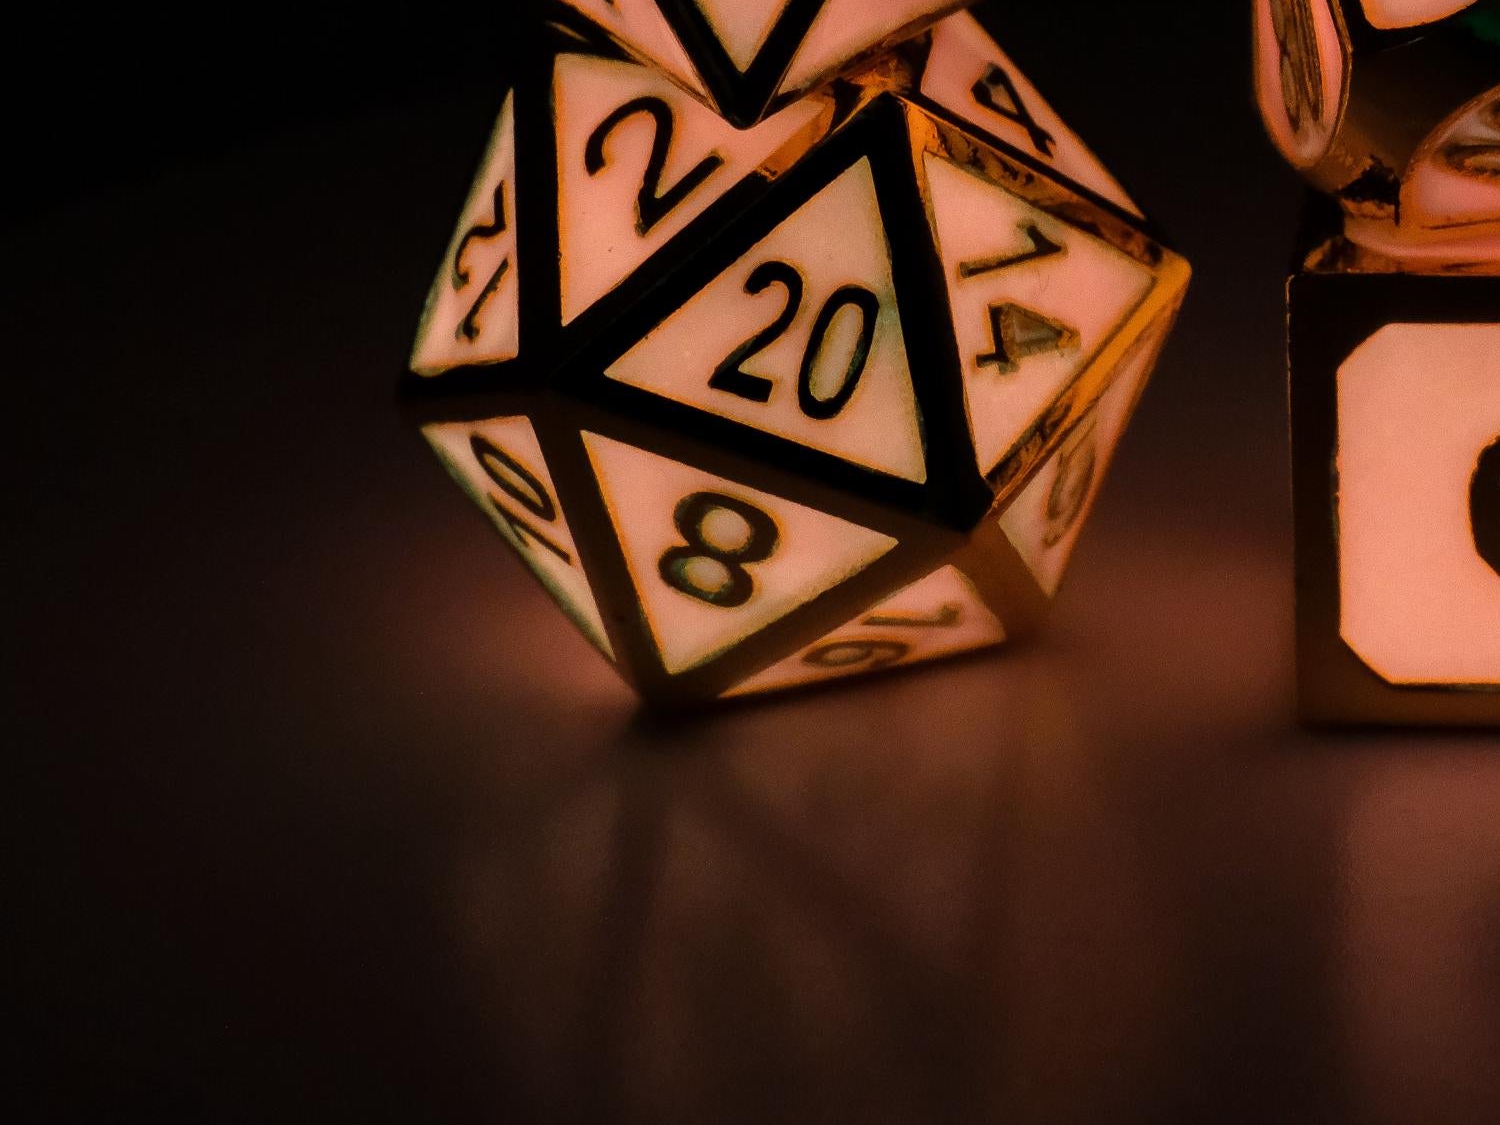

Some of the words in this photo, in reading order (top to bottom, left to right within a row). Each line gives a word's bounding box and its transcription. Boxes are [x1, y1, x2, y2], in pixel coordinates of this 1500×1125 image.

[584, 96, 724, 237] 2
[971, 62, 1056, 158] 4
[452, 180, 508, 342] 12
[957, 221, 1082, 376] 14
[709, 261, 881, 419] 20
[470, 434, 572, 564] 10
[657, 492, 780, 608] 8
